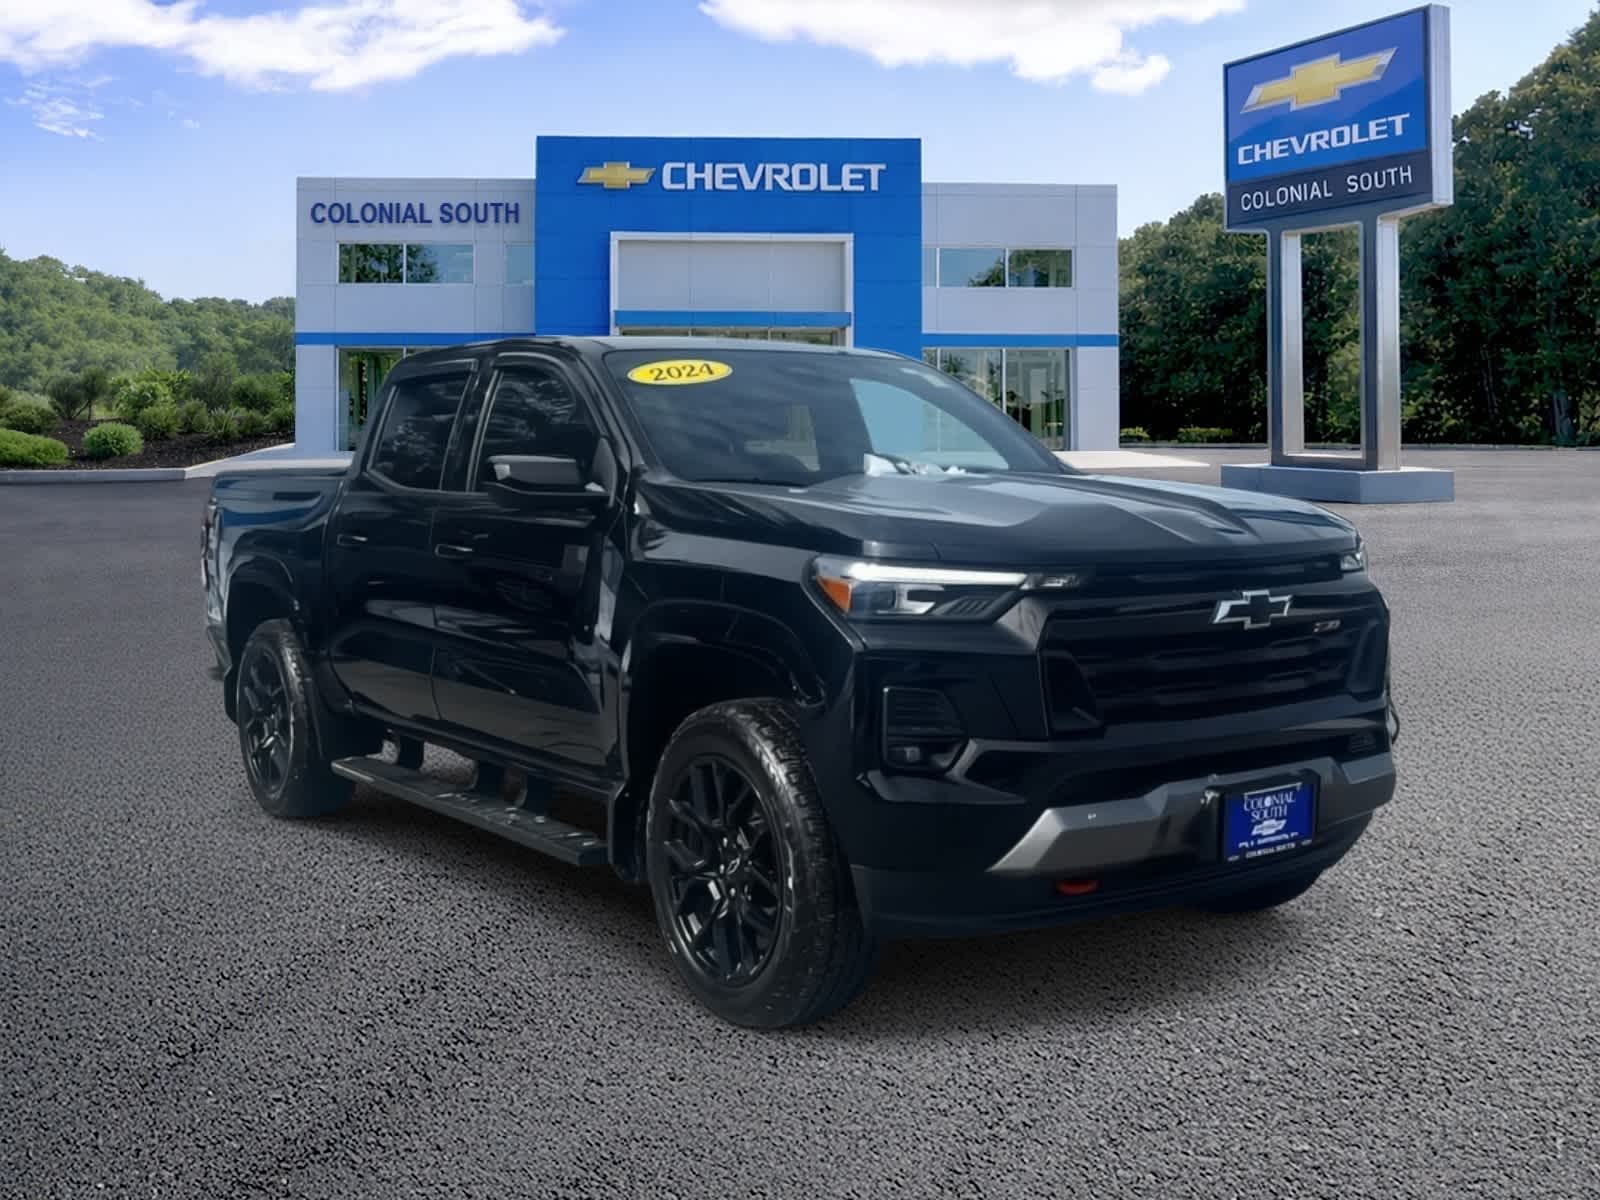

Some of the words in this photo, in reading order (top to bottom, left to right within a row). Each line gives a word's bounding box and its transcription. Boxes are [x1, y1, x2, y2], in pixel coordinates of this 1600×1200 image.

[1237, 113, 1410, 165] CHEVROLET
[662, 161, 887, 192] CHEVROLET
[1240, 180, 1333, 211] COLONIAL
[1346, 164, 1413, 194] SOUTH
[310, 202, 433, 224] COLONIAL
[439, 202, 520, 224] SOUTH
[648, 362, 715, 382] 2024
[1243, 792, 1296, 811] COLONIAL
[1251, 804, 1288, 820] SOUTH
